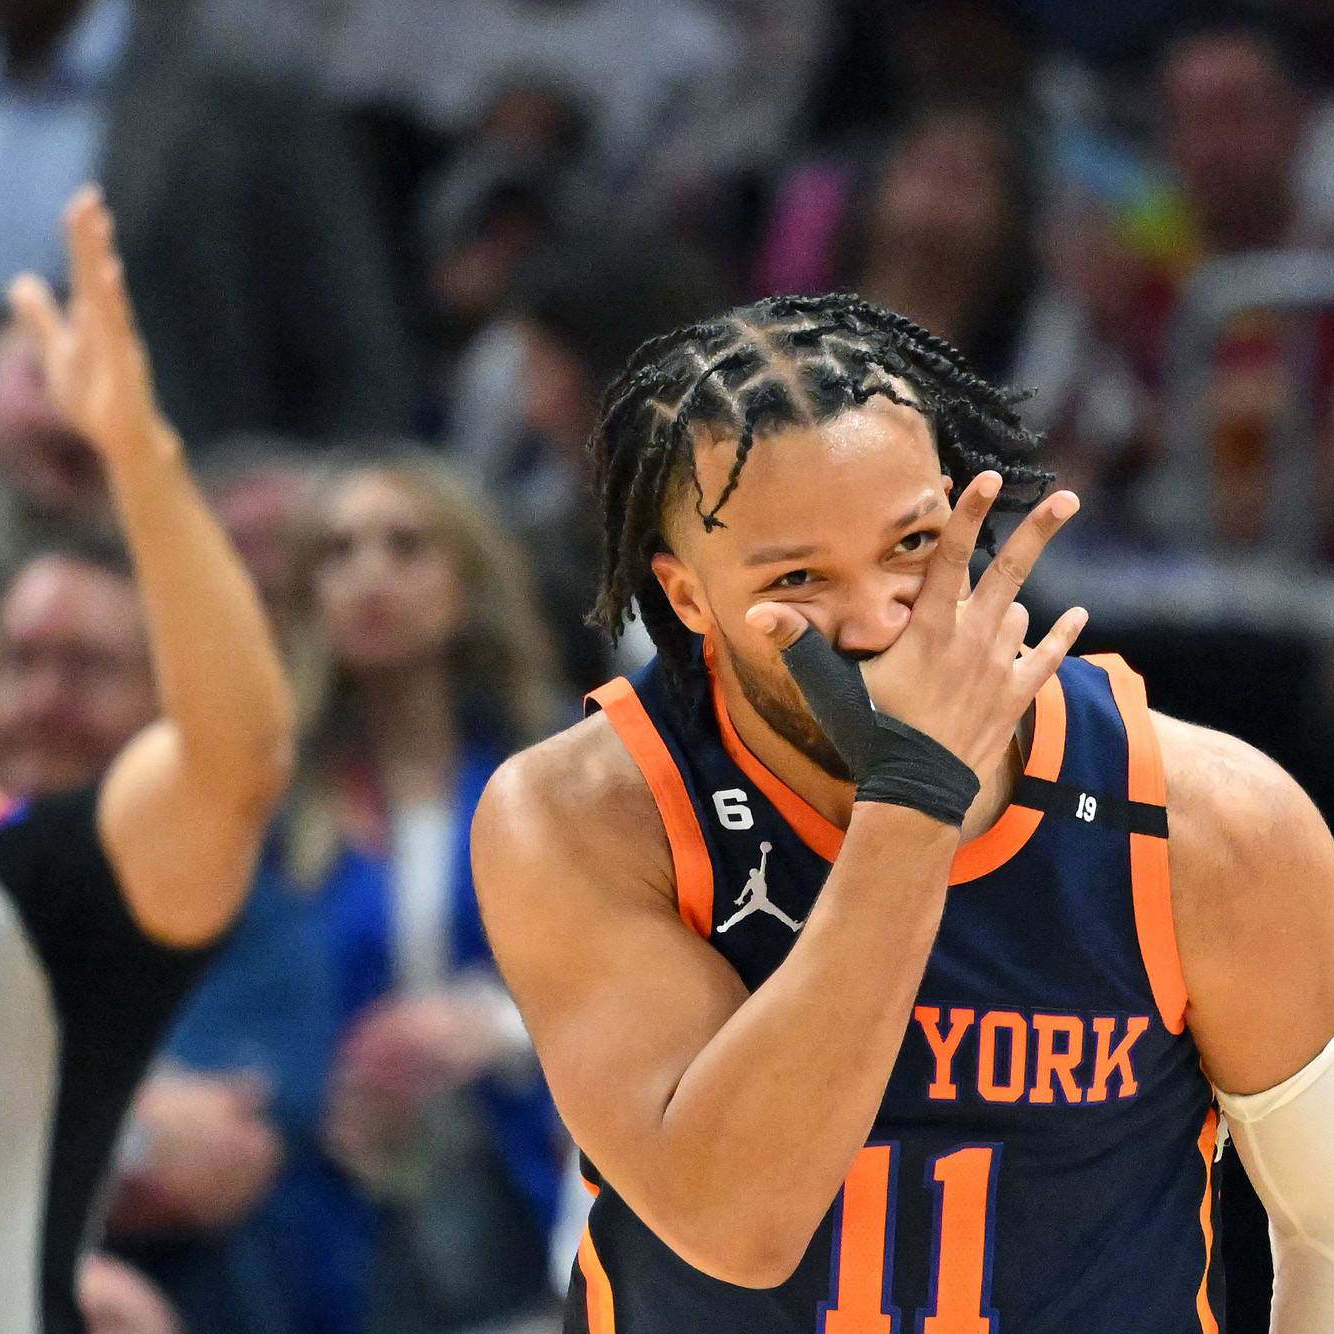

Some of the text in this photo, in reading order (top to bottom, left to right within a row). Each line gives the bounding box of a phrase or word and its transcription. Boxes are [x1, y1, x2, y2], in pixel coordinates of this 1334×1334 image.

[712, 789, 755, 830] 6
[1075, 792, 1097, 823] 19
[914, 1004, 1150, 1104] YORK
